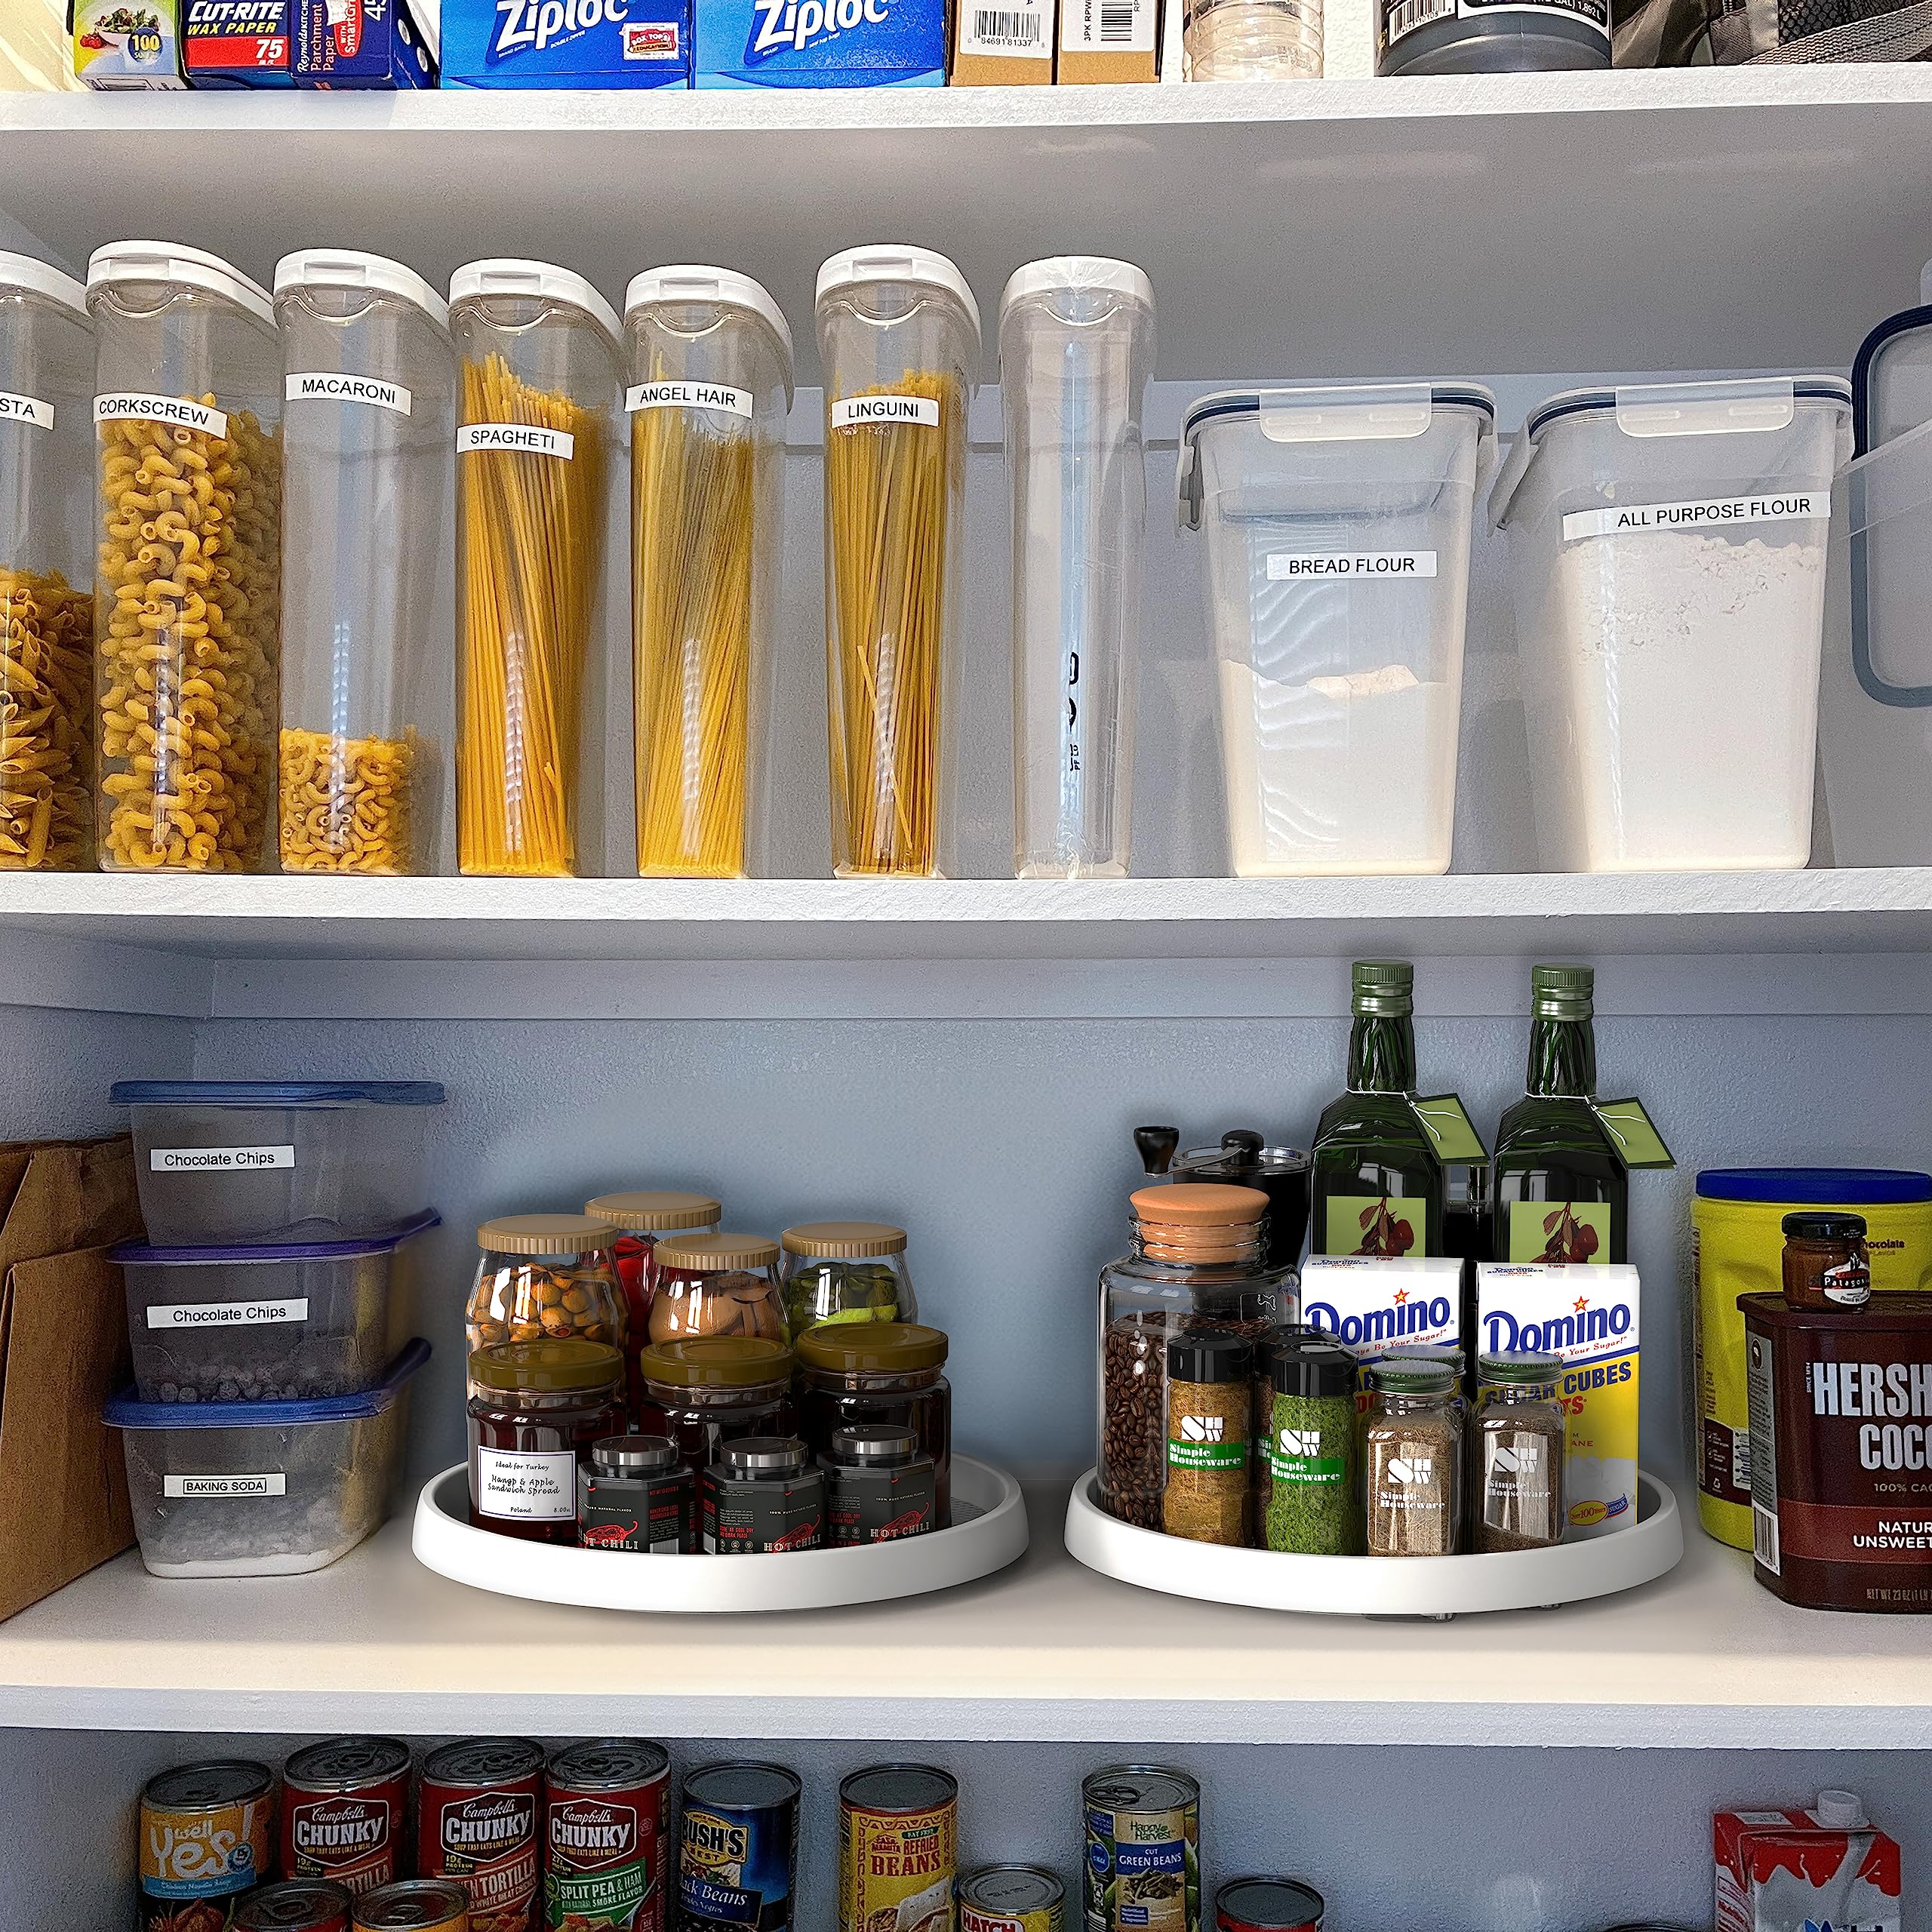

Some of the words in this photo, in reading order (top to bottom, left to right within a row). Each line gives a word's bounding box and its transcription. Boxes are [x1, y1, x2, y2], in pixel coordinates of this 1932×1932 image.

[189, 1, 282, 21] CUT-RITE
[187, 23, 221, 35] WAX
[226, 22, 277, 35] PAPER
[310, 3, 322, 72] Parchment
[131, 34, 160, 51] 100
[256, 39, 285, 59] 75
[631, 35, 648, 45] BOX
[323, 35, 337, 71] Paper
[302, 379, 396, 404] MACARONI
[639, 387, 690, 404] ANGEL
[696, 389, 737, 408] HAIR
[99, 400, 209, 426] CORKSCREW
[848, 401, 919, 419] LINGUINI
[469, 429, 555, 450] SPAGHETI
[1617, 510, 1651, 528] ALL
[1656, 503, 1745, 523] PURPOSE
[1750, 498, 1812, 515] FLOUR
[1288, 557, 1352, 575] BREAD
[1355, 557, 1416, 574] FLOUR
[164, 1153, 232, 1167] Chocolate
[235, 1152, 275, 1166] Chips
[172, 1308, 242, 1323] Chocolate
[245, 1305, 287, 1320] Chips
[1305, 1297, 1451, 1346] Domino
[1484, 1304, 1631, 1353] Domino
[1389, 1339, 1411, 1349] Your
[1569, 1347, 1591, 1356] Your
[1564, 1361, 1632, 1393] CUBES
[1170, 1444, 1211, 1457] Simple
[1170, 1453, 1241, 1466] Houseware
[1271, 1457, 1308, 1472] Simple
[1271, 1467, 1341, 1481] Houseware
[186, 1481, 229, 1492] BAKING
[231, 1481, 264, 1491] SODA
[488, 1483, 526, 1494] Sandwich
[528, 1487, 561, 1497] Spread
[519, 1478, 526, 1486] &
[529, 1478, 555, 1489] Apple
[1487, 1479, 1527, 1488] Simple
[1874, 1483, 1907, 1493] 100%
[1380, 1491, 1420, 1500] Simple
[1487, 1488, 1552, 1498] Houseware
[1380, 1500, 1446, 1509] Houseware
[1580, 1507, 1595, 1518] 100
[1609, 1500, 1626, 1513] SUGAR
[870, 1528, 899, 1538] HOT
[902, 1521, 930, 1535] CHILI
[601, 1539, 638, 1549] CHILI
[764, 1542, 792, 1552] HOT
[795, 1534, 821, 1549] CHILI
[297, 1816, 383, 1846] CHUNKY
[446, 1810, 531, 1843] CHUNKY
[552, 1817, 631, 1848] CHUNKY
[903, 1834, 940, 1855] REFRIED
[690, 1847, 721, 1862] BEST
[870, 1850, 942, 1877] BEANS
[1118, 1855, 1152, 1866] GREEN
[1152, 1852, 1183, 1866] BEANS
[479, 1855, 536, 1897] TORTILLA
[561, 1885, 589, 1900] SPLIT
[592, 1881, 615, 1898] PEA
[617, 1878, 624, 1892] &
[592, 1894, 618, 1908] SMOKE
[618, 1886, 642, 1902] FLAVOR
[701, 1884, 748, 1906] Beans
